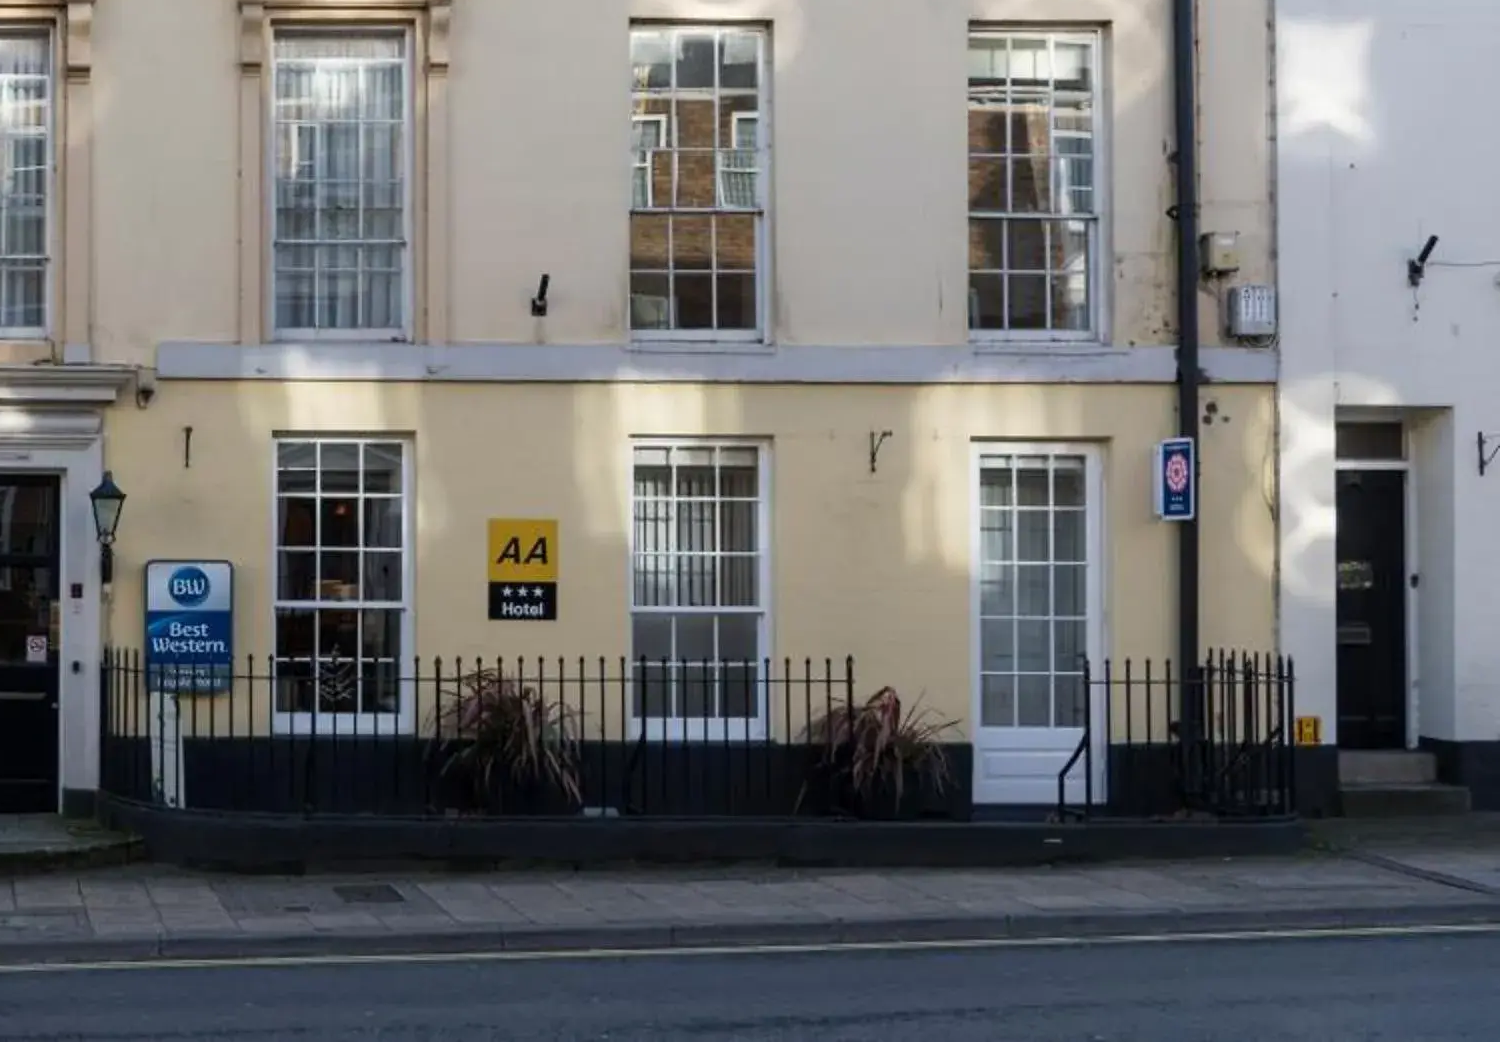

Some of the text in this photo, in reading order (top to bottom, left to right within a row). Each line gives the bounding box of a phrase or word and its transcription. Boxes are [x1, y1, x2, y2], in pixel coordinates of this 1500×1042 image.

[496, 536, 548, 565] AA
[173, 579, 205, 595] BW
[502, 602, 543, 616] Hotel
[170, 622, 209, 637] Best
[153, 638, 226, 653] Western
